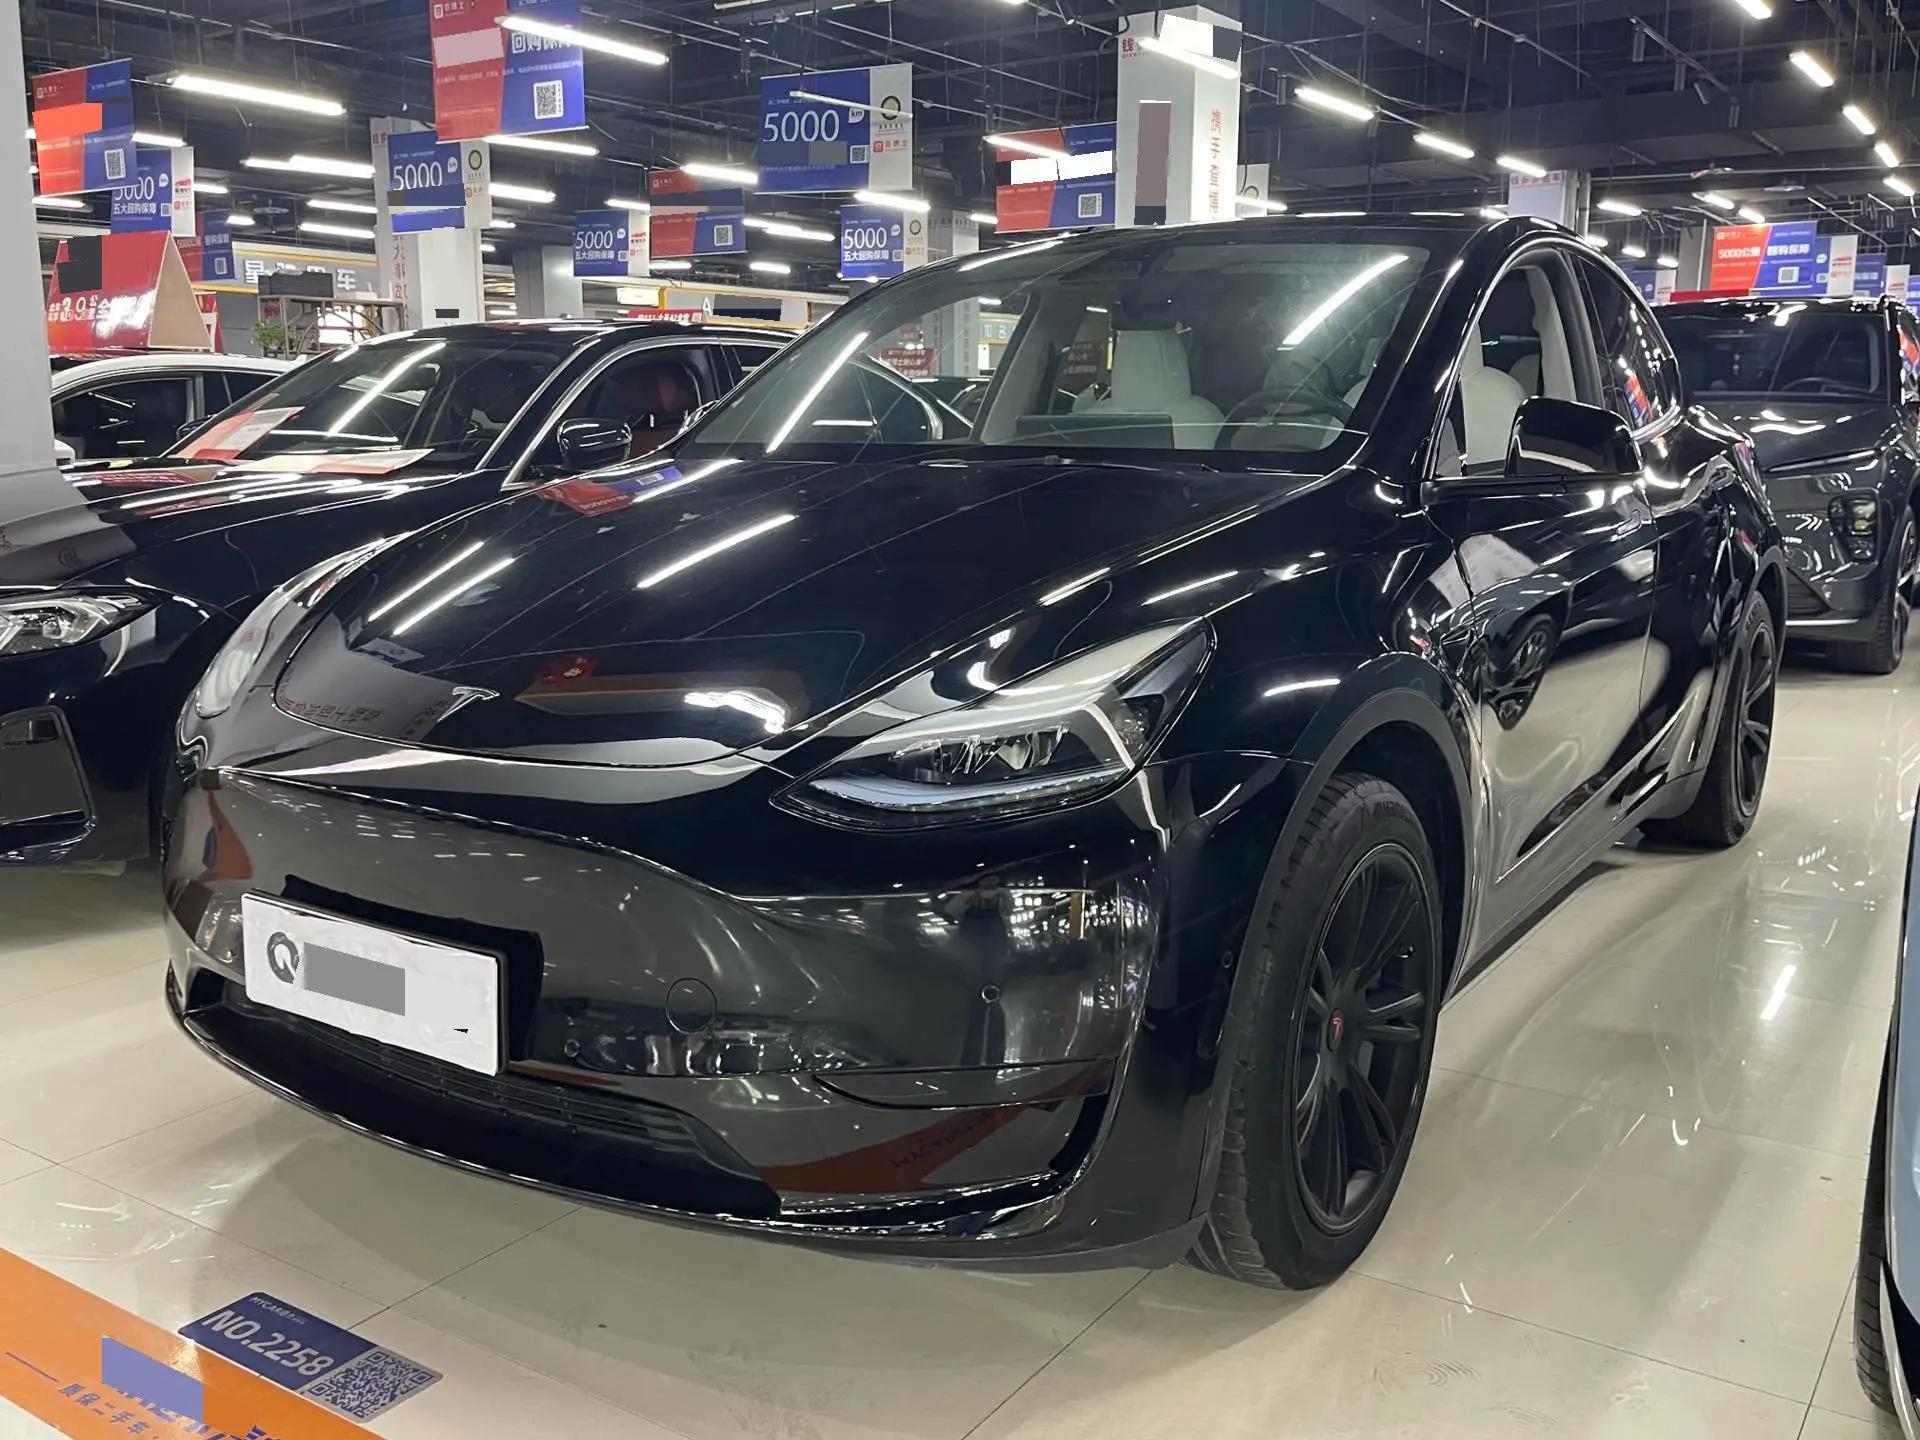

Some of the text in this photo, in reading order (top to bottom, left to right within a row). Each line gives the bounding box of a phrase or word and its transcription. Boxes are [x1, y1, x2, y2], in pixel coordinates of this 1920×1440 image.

[762, 109, 840, 142] 5000
[575, 230, 613, 250] 5000
[843, 227, 888, 250] 5000
[201, 1309, 335, 1377] NO.2258
